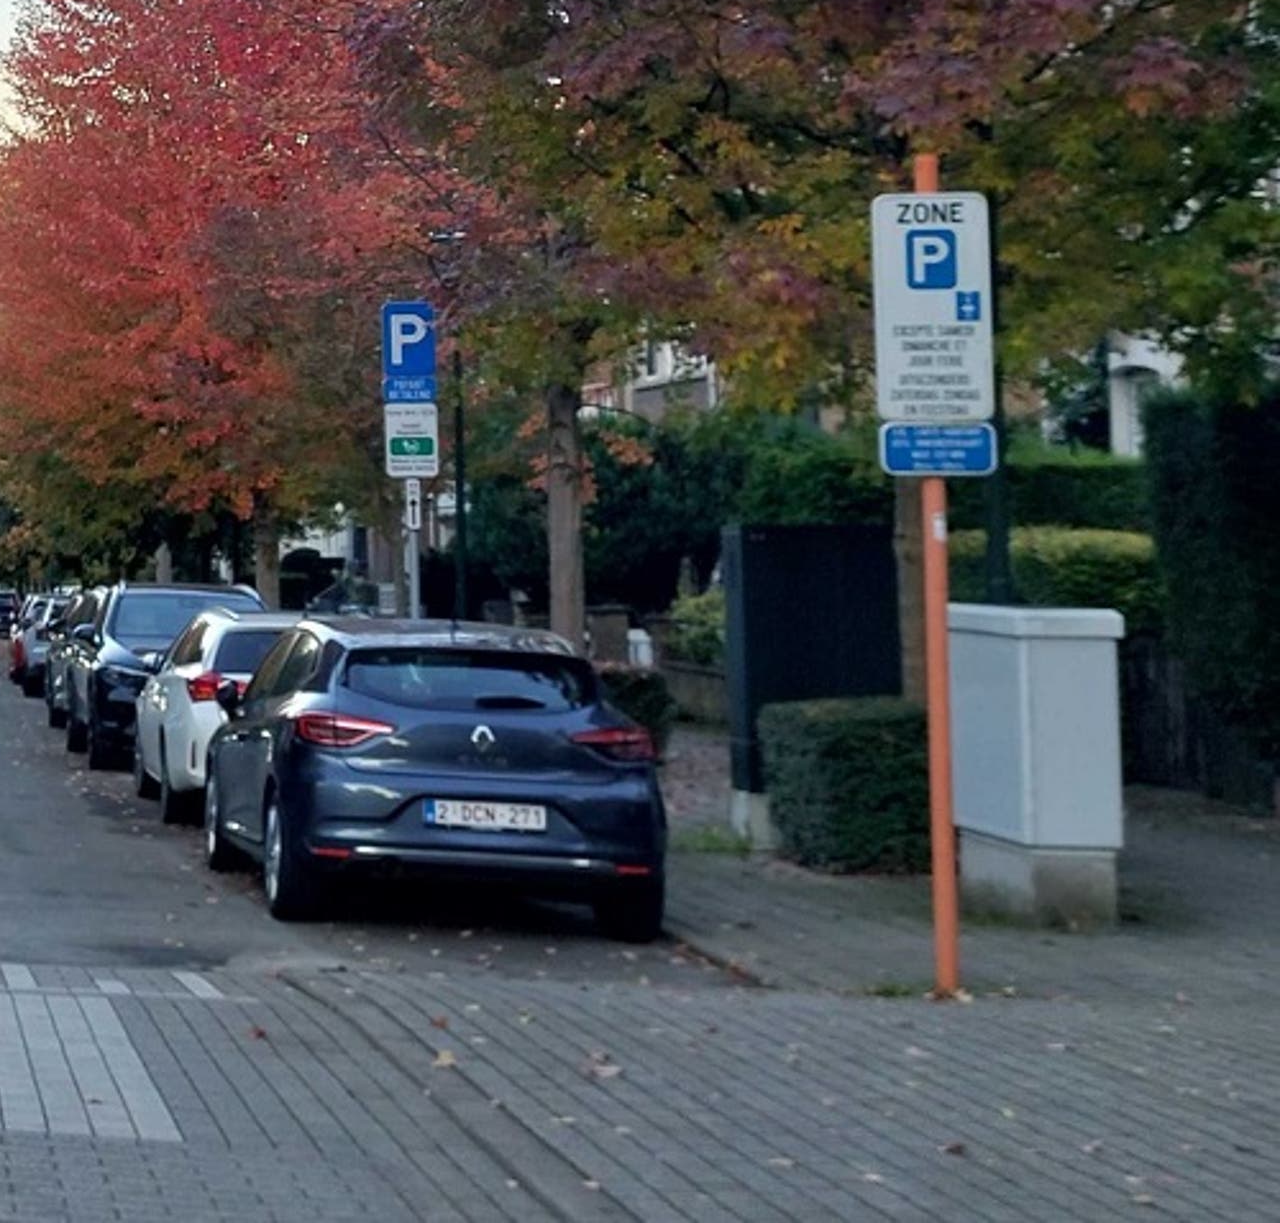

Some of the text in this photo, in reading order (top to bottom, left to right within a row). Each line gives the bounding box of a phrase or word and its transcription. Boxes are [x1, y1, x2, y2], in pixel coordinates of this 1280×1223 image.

[896, 202, 965, 224] ZONE
[912, 236, 951, 284] P
[390, 313, 428, 366] P
